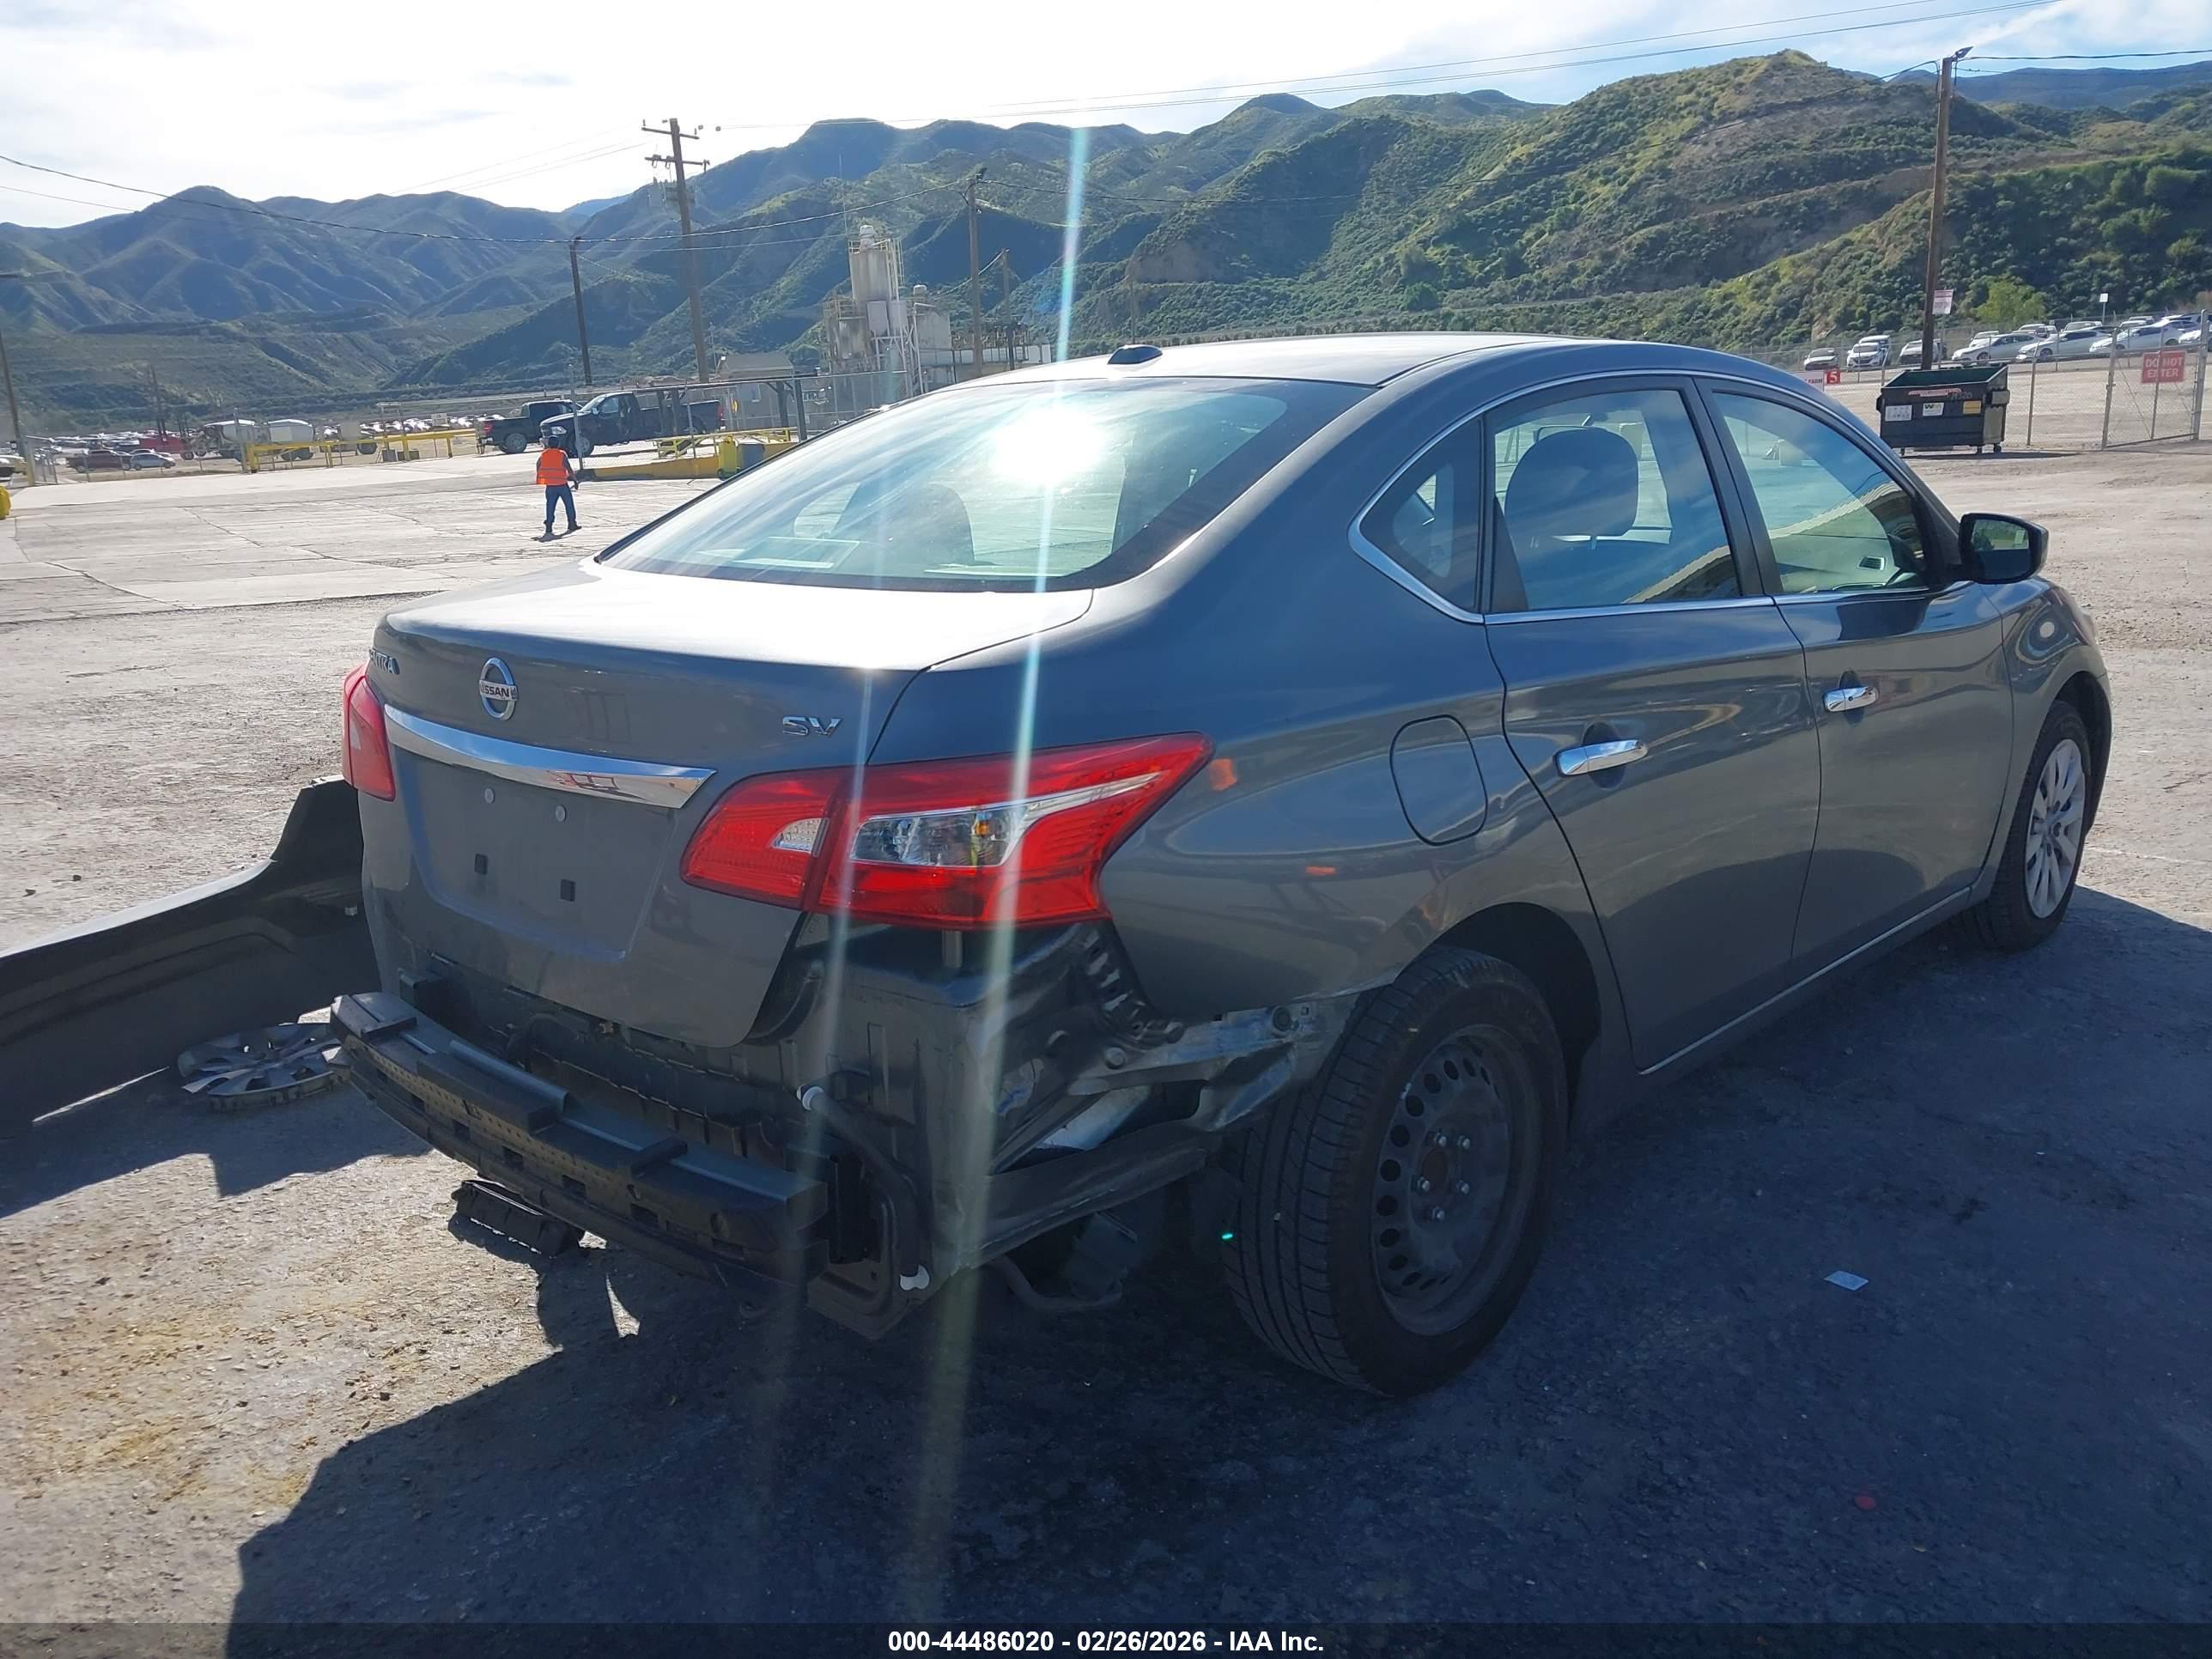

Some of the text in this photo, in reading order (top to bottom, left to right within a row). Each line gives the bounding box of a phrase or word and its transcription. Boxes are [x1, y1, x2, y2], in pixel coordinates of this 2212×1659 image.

[1829, 371, 1838, 383] 5
[481, 684, 509, 697] NISSAN
[782, 716, 842, 736] SV
